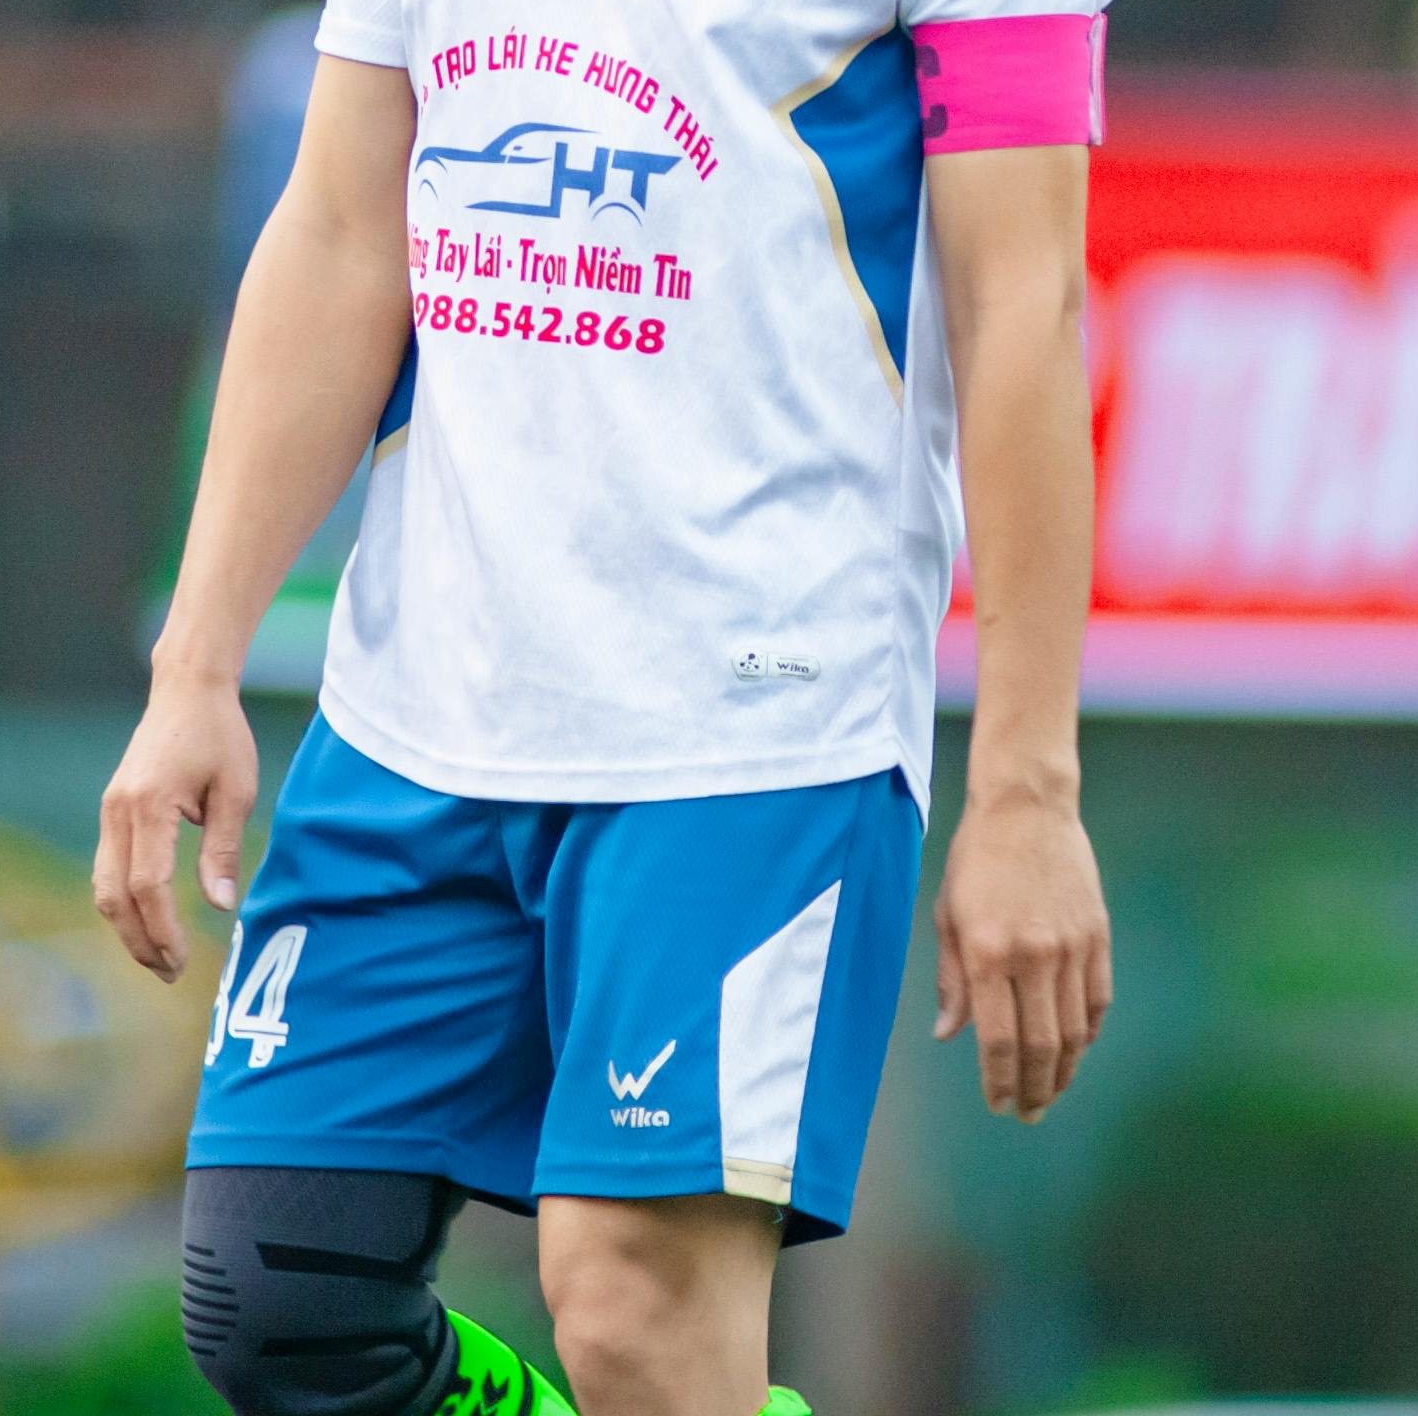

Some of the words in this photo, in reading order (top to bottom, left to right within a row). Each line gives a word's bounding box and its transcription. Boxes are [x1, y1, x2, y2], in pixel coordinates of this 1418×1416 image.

[432, 39, 476, 90] TẠO
[488, 25, 527, 71] LÁI
[535, 35, 579, 76] XE
[663, 95, 719, 182] THÁI
[435, 228, 469, 283] Tay
[474, 232, 501, 278] Lái
[519, 238, 567, 295] Trọn
[653, 253, 692, 300] Tin
[411, 292, 666, 355] 988.542.868
